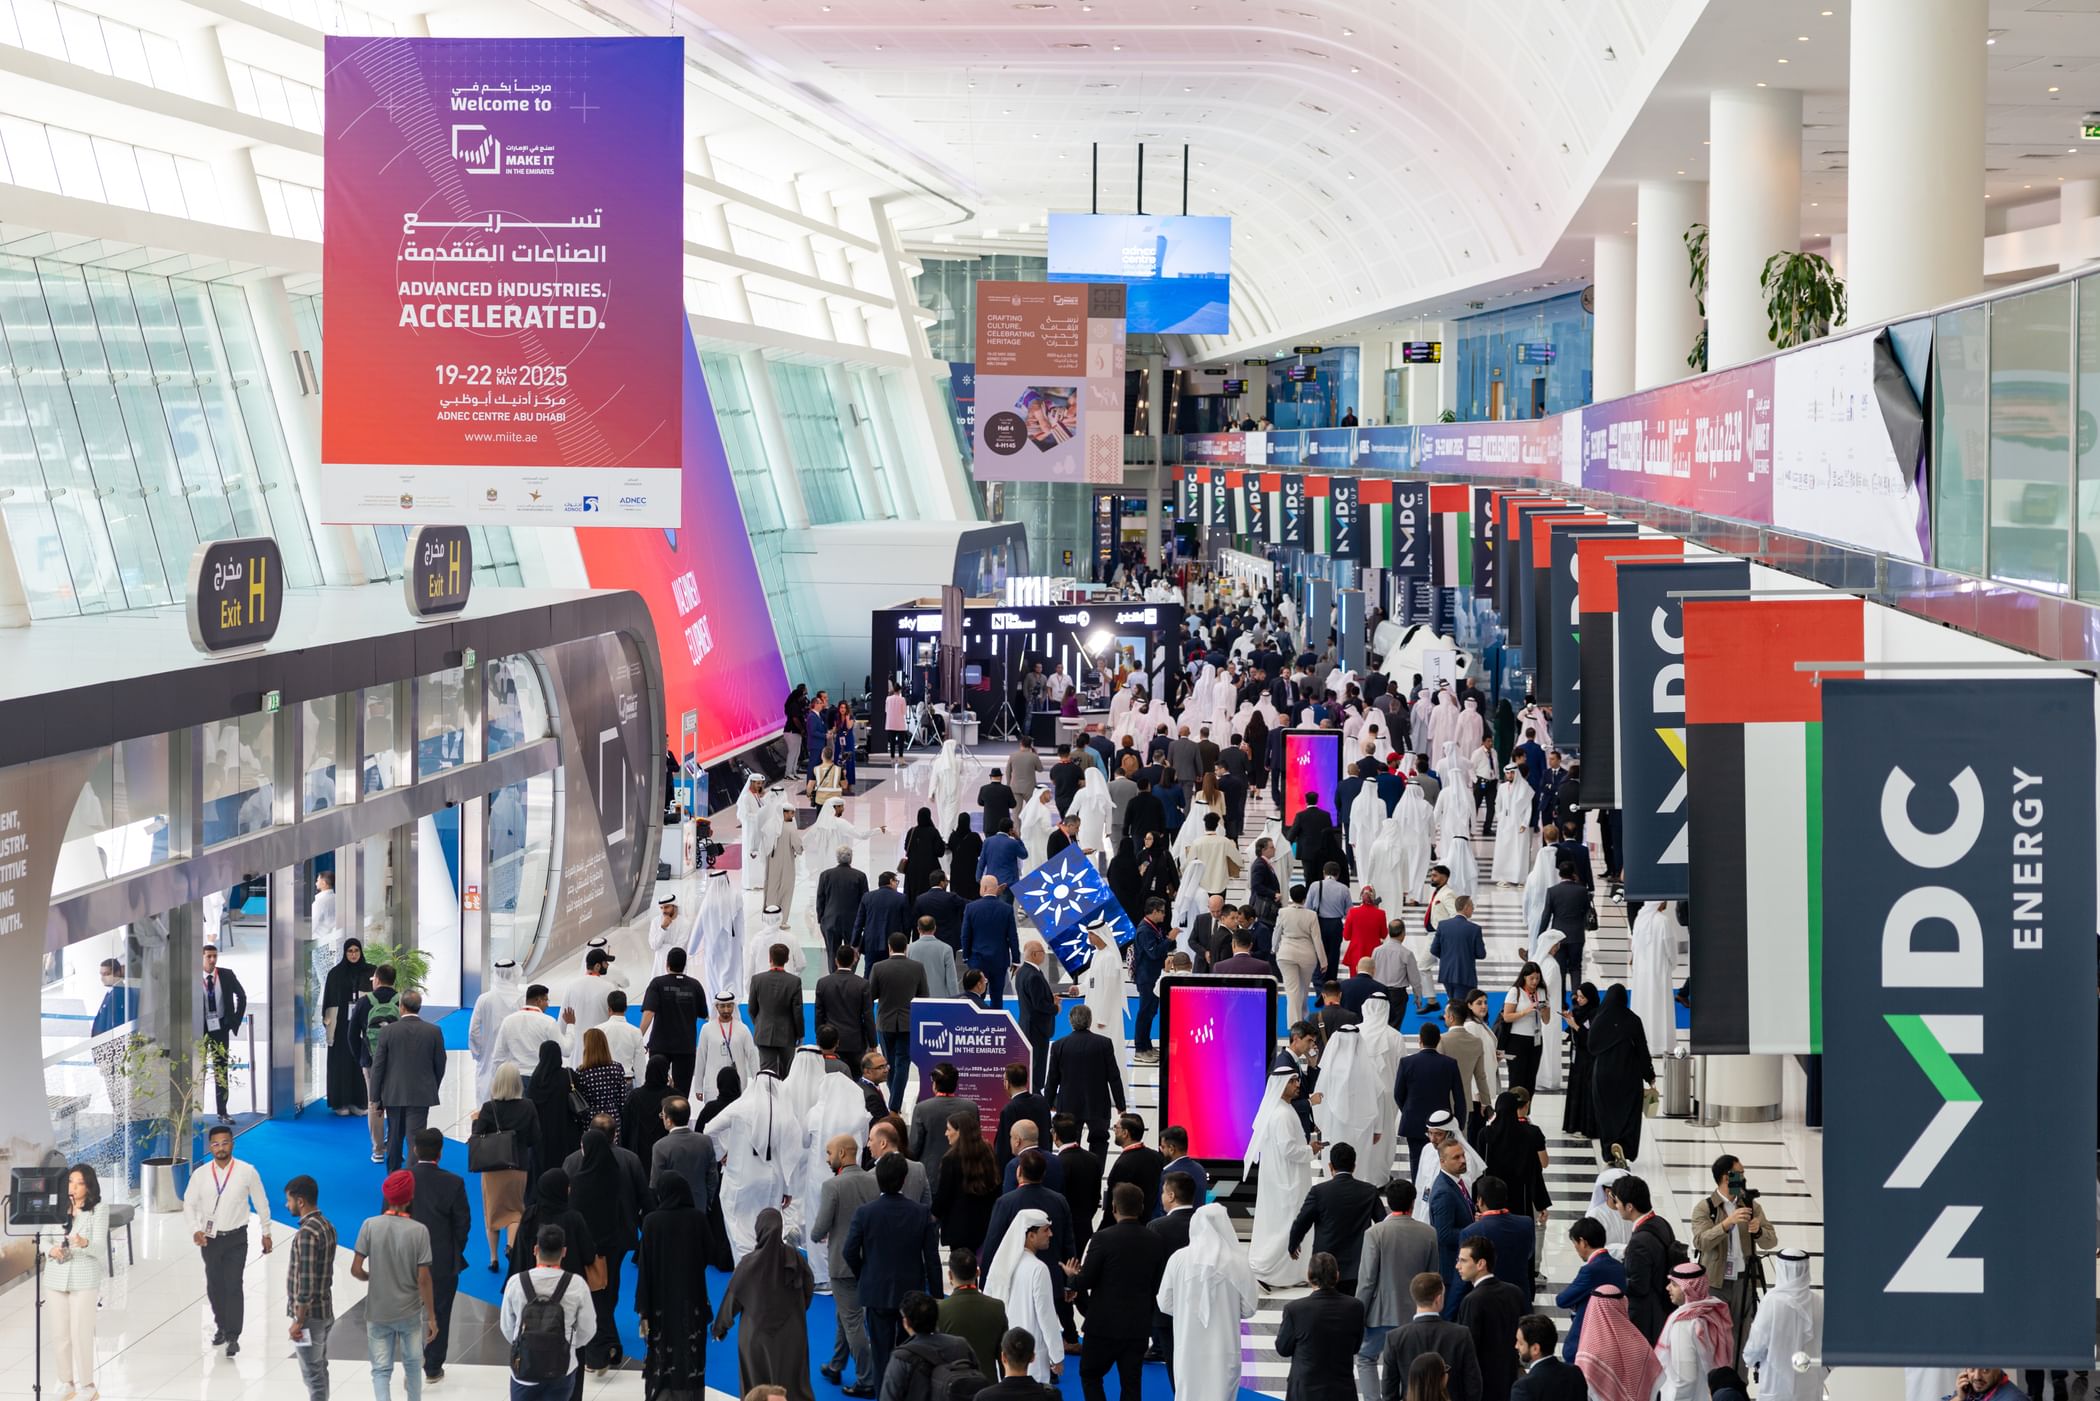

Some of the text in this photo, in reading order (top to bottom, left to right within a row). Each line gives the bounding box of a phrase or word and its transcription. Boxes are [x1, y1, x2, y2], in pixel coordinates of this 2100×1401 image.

[451, 82, 479, 96] في
[481, 82, 511, 95] بكم
[451, 97, 552, 112] Welcome to
[529, 145, 540, 153] في
[505, 155, 555, 166] MAKE IT
[511, 243, 607, 263] الصناعات
[398, 281, 607, 298] ADVANCED INDUSTRIES.
[398, 303, 606, 329] ACCELERATED.
[987, 314, 1023, 322] CRAFTING
[987, 338, 1022, 346] HERITAGE
[435, 364, 492, 385] 19-22
[496, 365, 518, 376] مايو
[519, 365, 568, 387] 2025
[496, 376, 518, 386] MAY
[494, 391, 532, 407] أدنيك
[534, 396, 566, 408] مركز
[437, 411, 566, 422] ADNEC CENTRE ABU DHABI
[464, 432, 538, 443] www.miite.ae
[619, 496, 647, 504] ADNEC
[1215, 475, 1225, 523] NMDC
[1248, 480, 1263, 533] NMDC
[1286, 482, 1298, 541] NMDC
[1335, 488, 1349, 552] NMDC
[1400, 493, 1415, 567] NMDC
[424, 537, 445, 567] مخرج
[213, 556, 243, 591] مخرج
[448, 540, 461, 595] H
[248, 556, 266, 624] H
[428, 573, 445, 599] Exit
[220, 598, 242, 629] Exit
[898, 616, 917, 631] sky
[2013, 766, 2044, 950] ENERGY
[0, 912, 23, 936] WTH.
[979, 1025, 990, 1034] في
[1880, 765, 1985, 1293] NMDC
[955, 1035, 1007, 1046] MAKE IT
[975, 1047, 1007, 1055] EMIRATES
